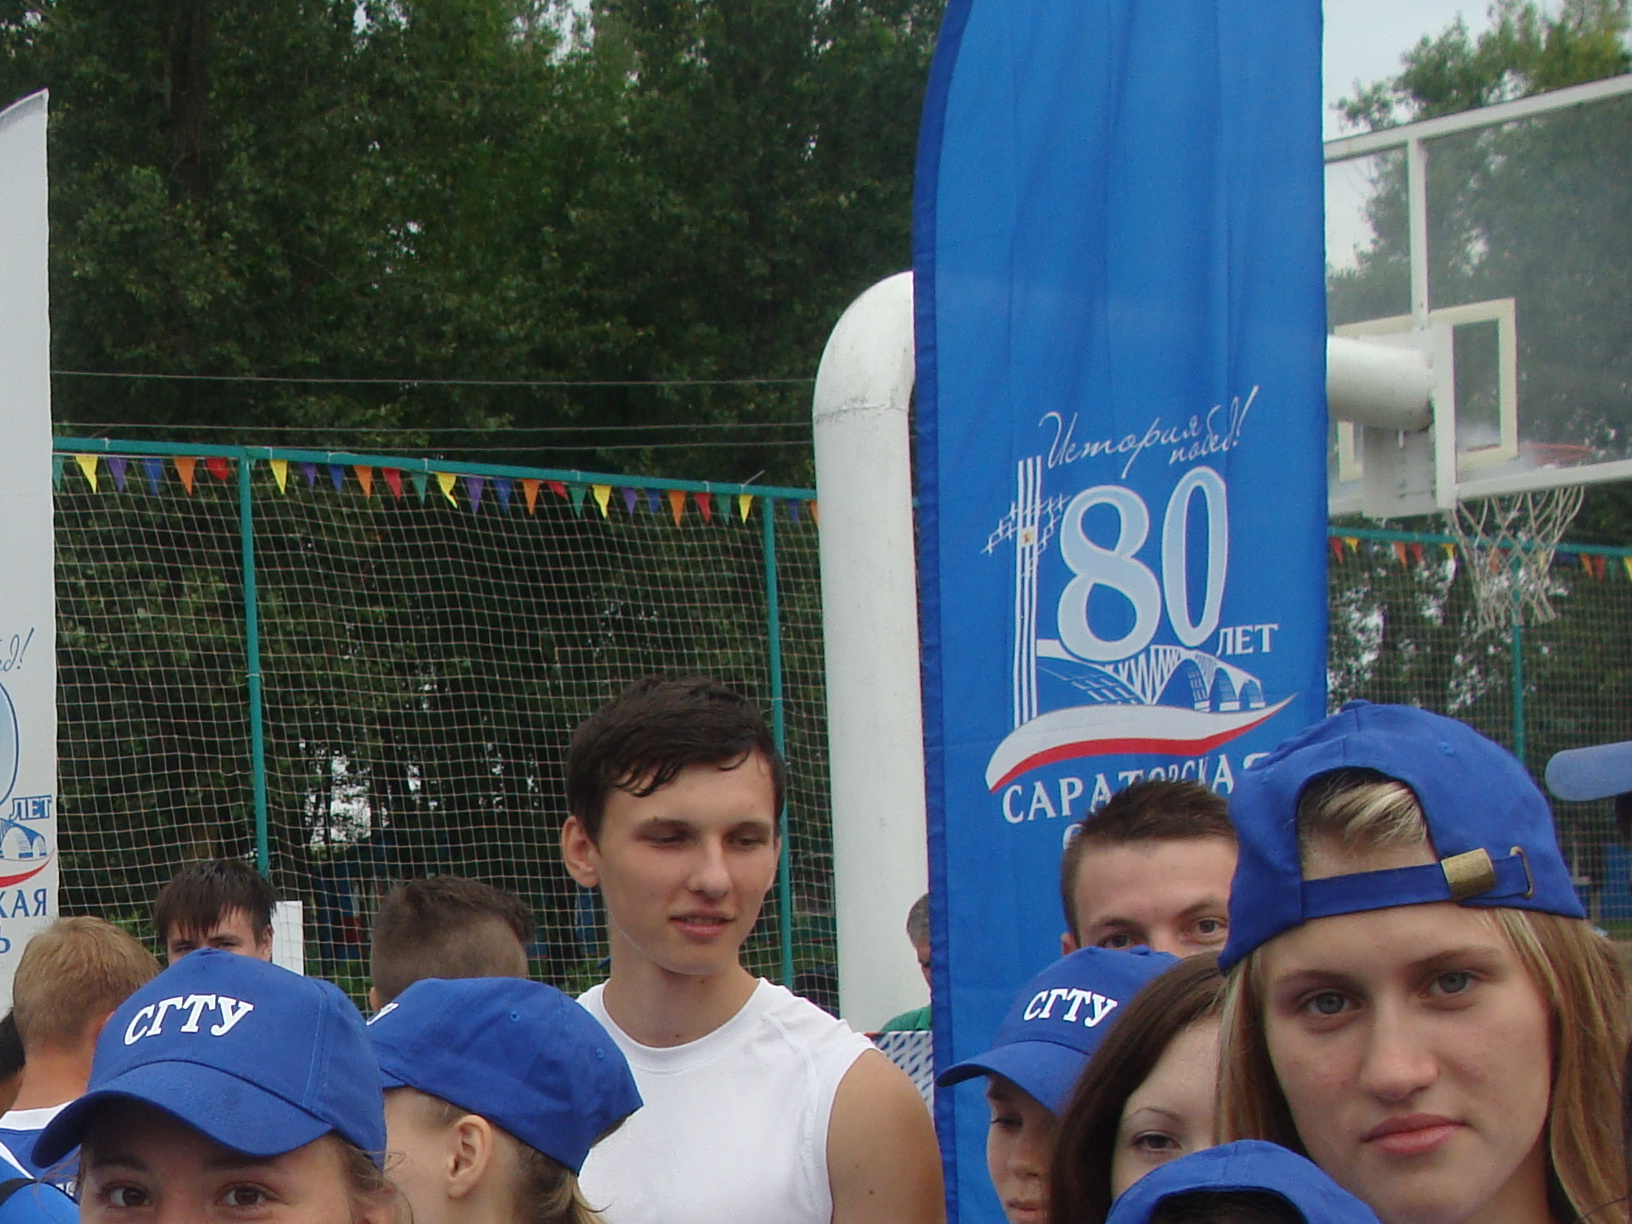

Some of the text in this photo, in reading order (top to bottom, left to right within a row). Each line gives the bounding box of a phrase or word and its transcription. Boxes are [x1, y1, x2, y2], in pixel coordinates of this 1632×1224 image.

[1038, 410, 1200, 480] История
[1057, 465, 1279, 662] 80 ЛЕТ
[9, 795, 52, 822] ЛЕТ
[123, 993, 254, 1046] СГТУ
[1023, 987, 1119, 1028] СГТУ
